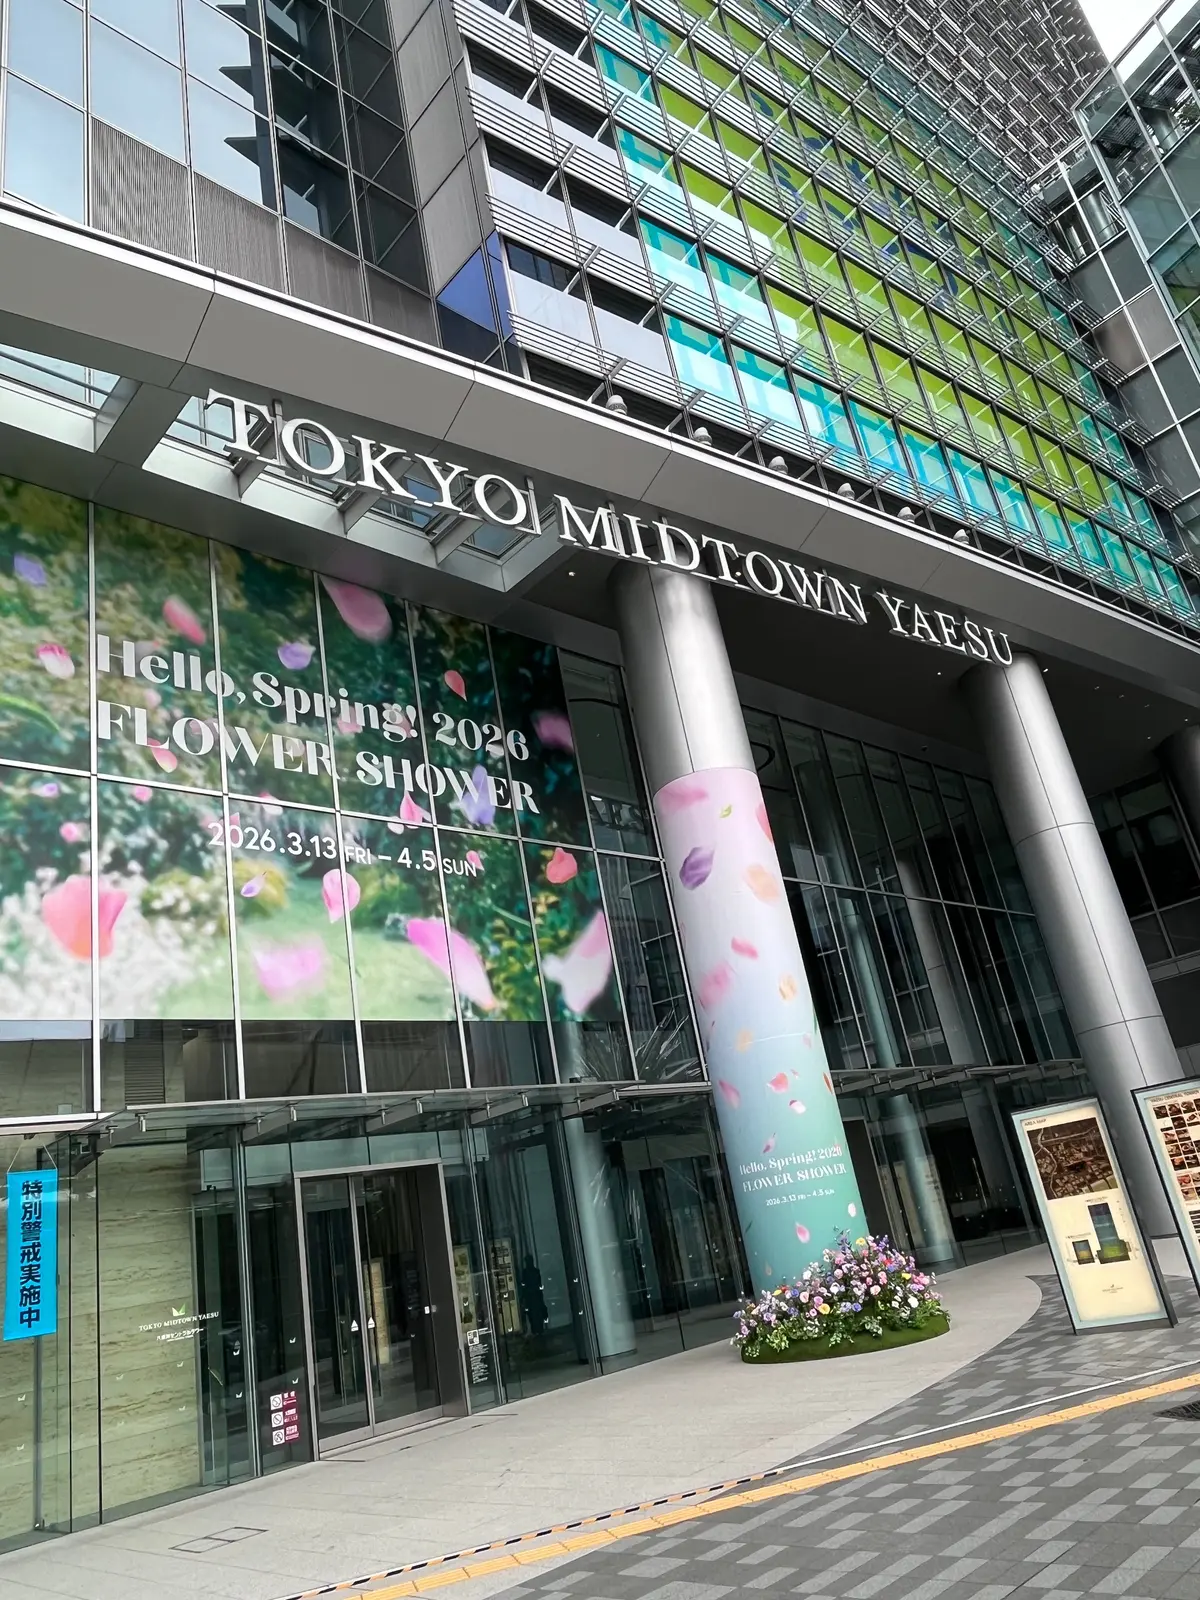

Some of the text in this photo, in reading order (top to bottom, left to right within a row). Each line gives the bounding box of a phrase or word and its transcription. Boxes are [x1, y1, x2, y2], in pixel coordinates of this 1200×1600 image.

[204, 388, 1013, 667] TOKYO MIDTOWN YAESU
[97, 699, 340, 780] FLOWER
[356, 750, 540, 815] SHOWER
[432, 711, 530, 762] 2026
[208, 822, 337, 860] 2026.3.13
[344, 846, 372, 866] FRI
[397, 847, 436, 872] 4.5
[443, 858, 477, 878] SUN
[743, 1164, 846, 1192] FLOWER SHOWER
[769, 1151, 816, 1170] Spring!
[19, 1180, 43, 1329] 特別警戒実施中
[139, 1312, 219, 1331] TOKYO MIDTOWN YAESU
